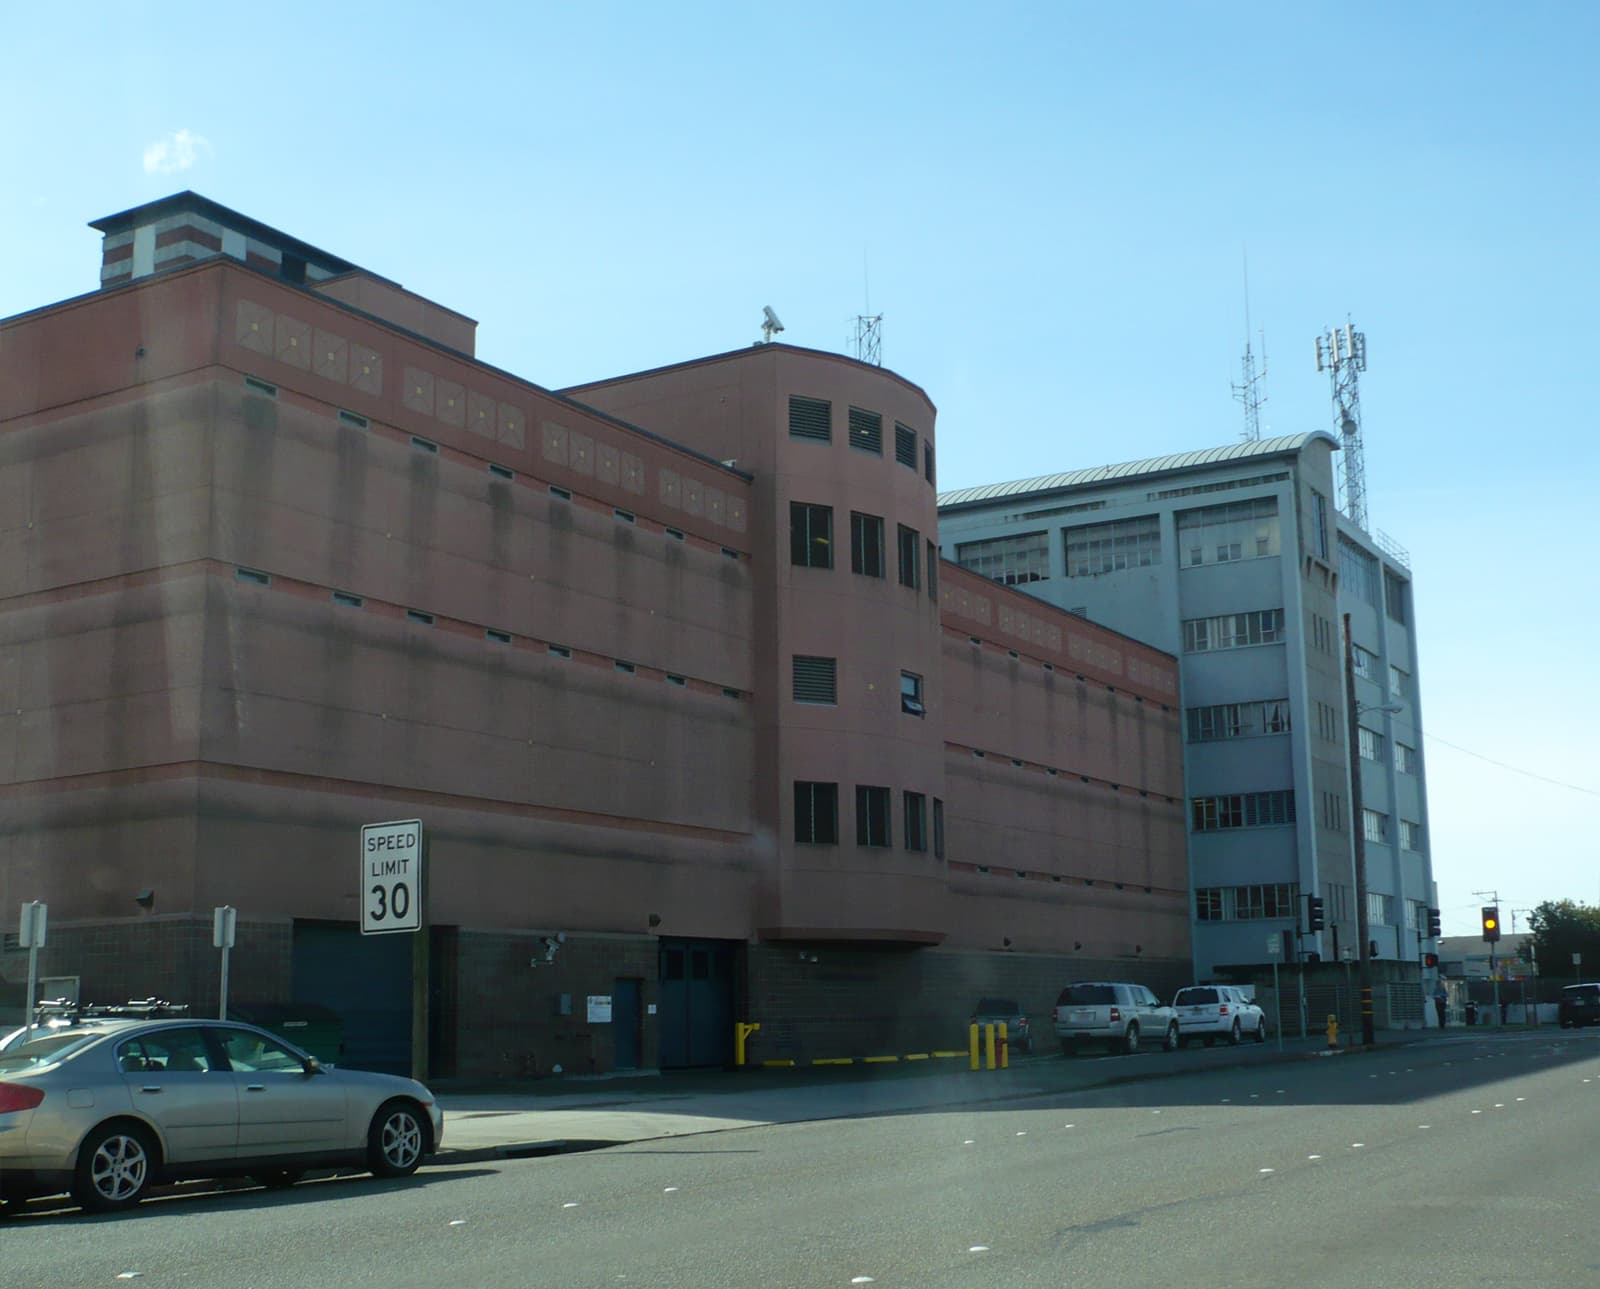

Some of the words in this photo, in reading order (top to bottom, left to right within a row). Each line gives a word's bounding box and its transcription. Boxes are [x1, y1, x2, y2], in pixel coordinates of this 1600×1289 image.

[367, 833, 416, 852] SPEED
[371, 859, 410, 877] LIMIT
[370, 882, 409, 921] 30
